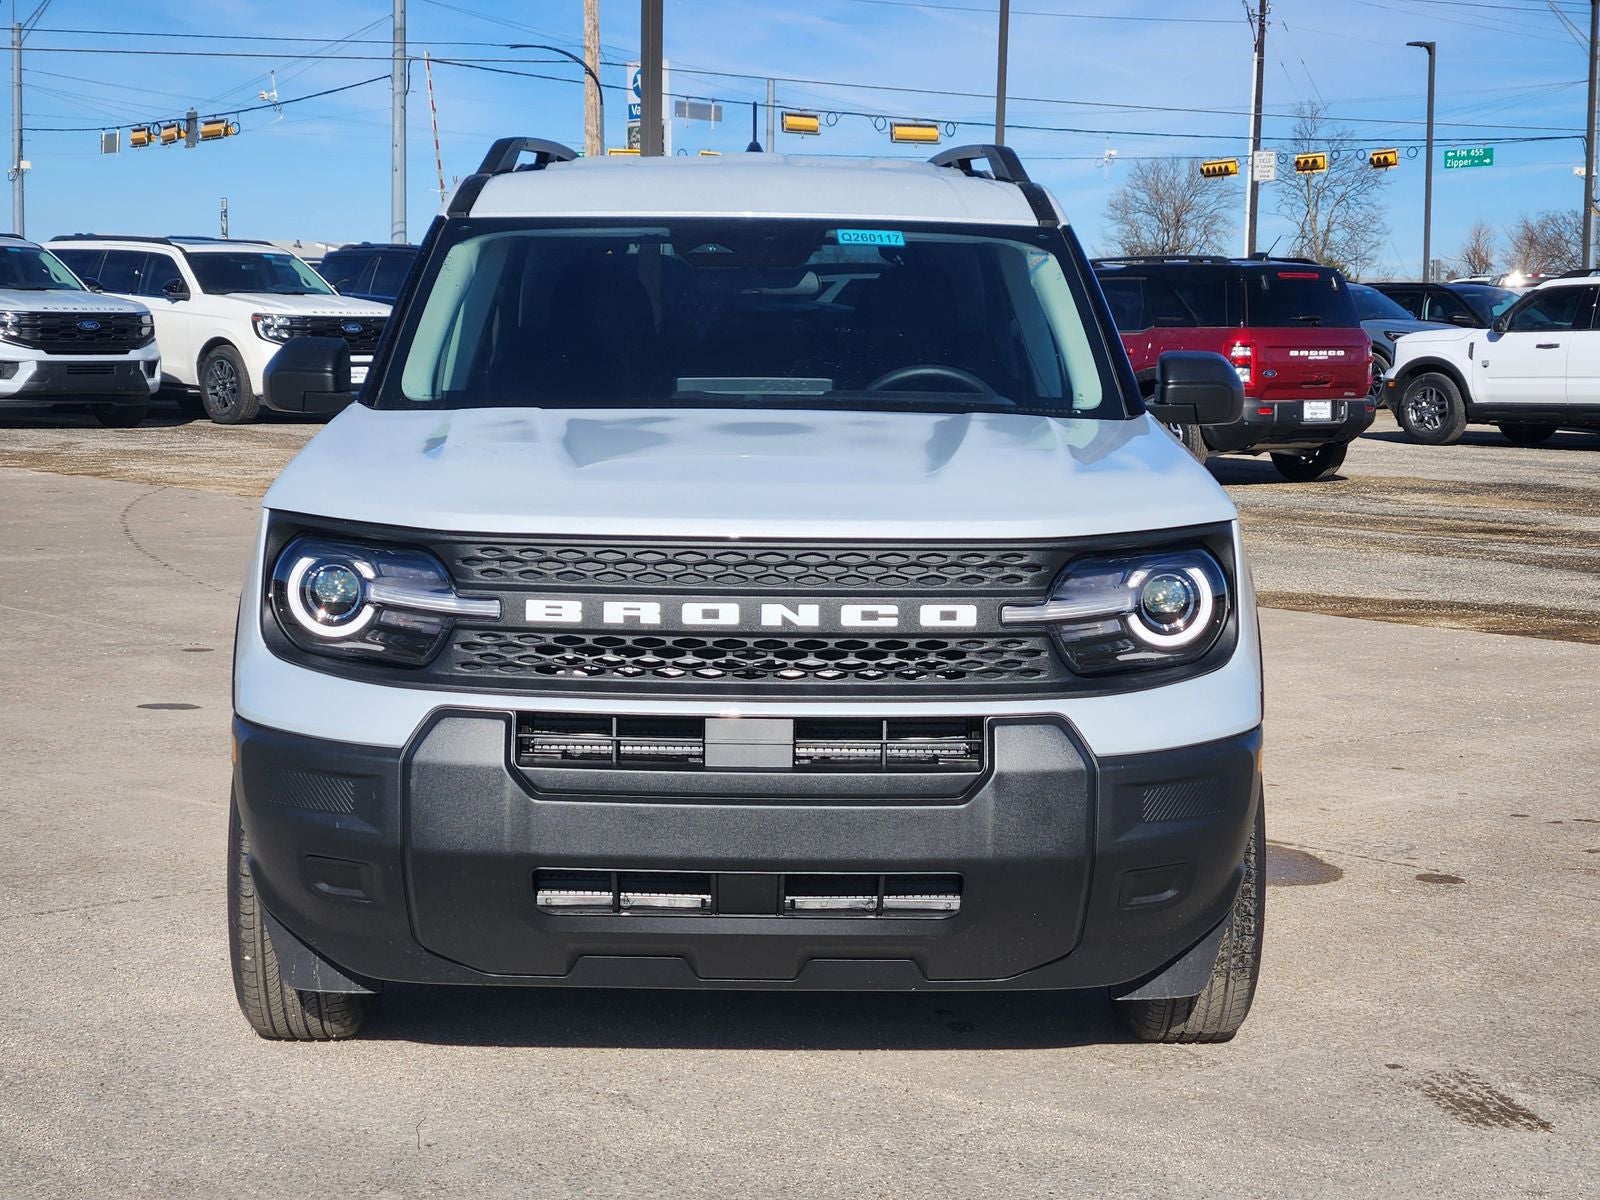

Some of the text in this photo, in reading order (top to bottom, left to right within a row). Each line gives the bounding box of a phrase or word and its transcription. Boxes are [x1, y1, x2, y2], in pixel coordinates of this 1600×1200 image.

[1470, 148, 1484, 156] 455
[1446, 159, 1472, 168] Zipper
[841, 232, 900, 243] Q260117
[525, 599, 978, 627] BRONCO
